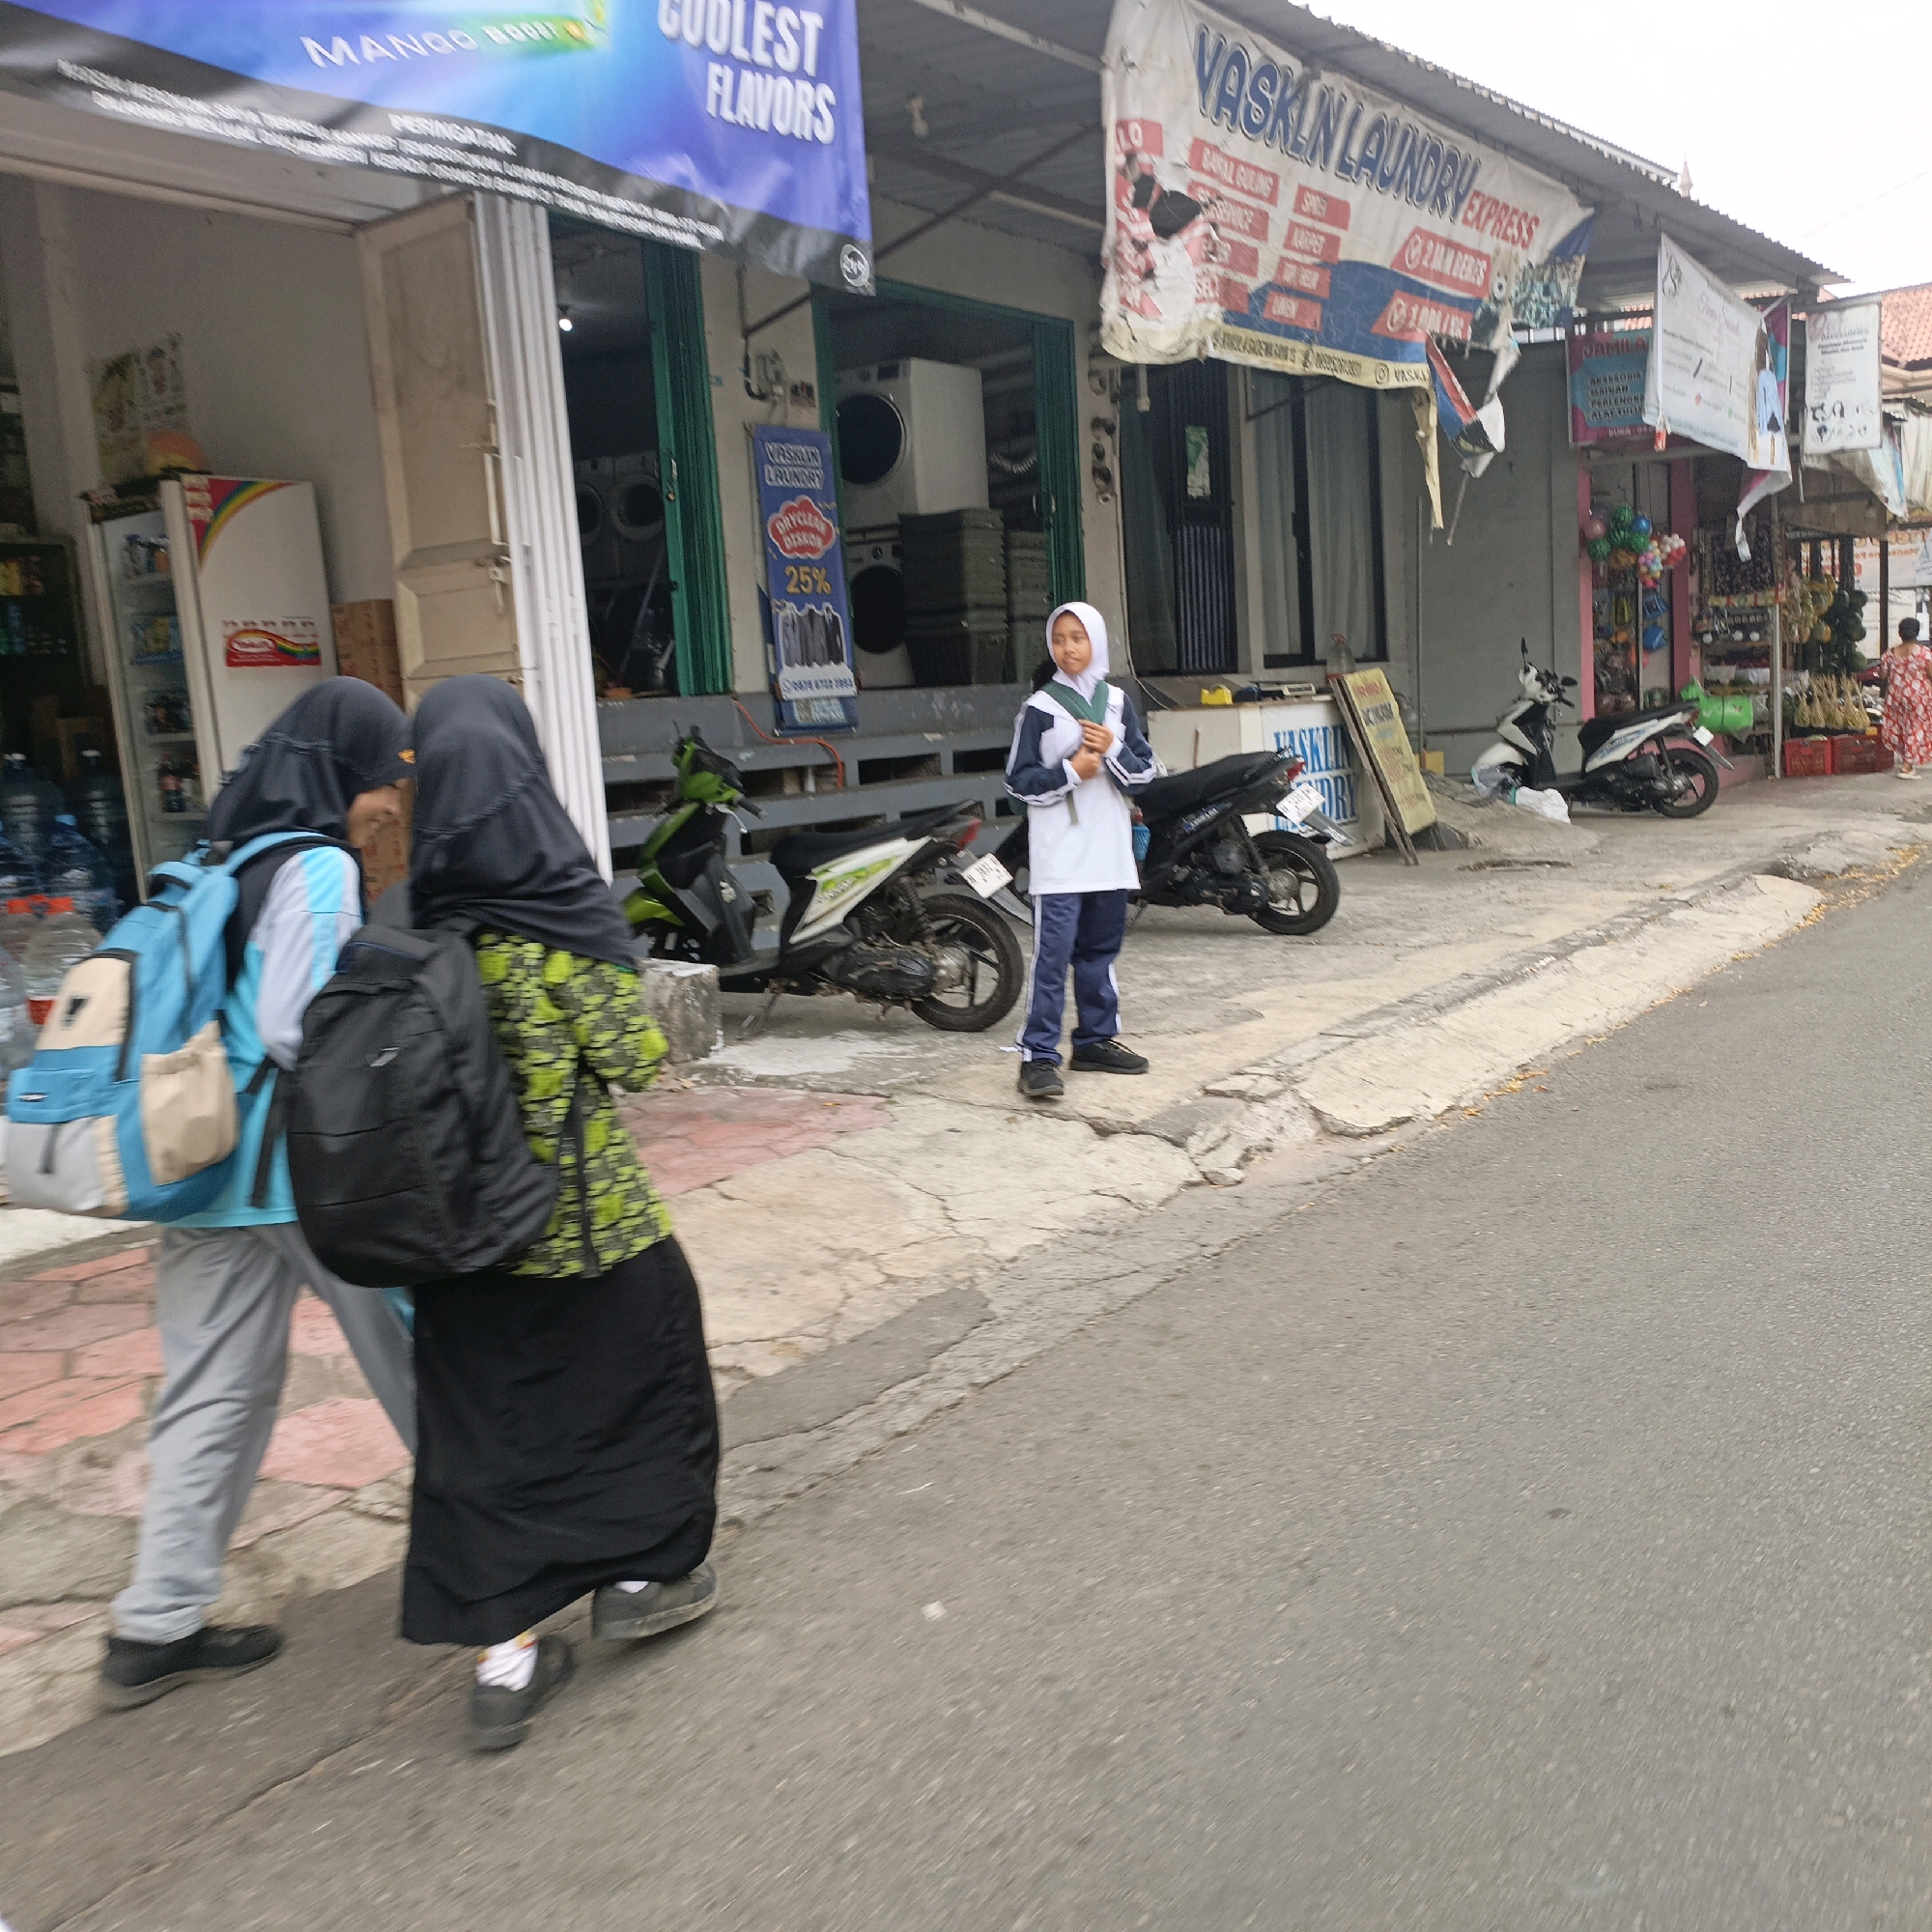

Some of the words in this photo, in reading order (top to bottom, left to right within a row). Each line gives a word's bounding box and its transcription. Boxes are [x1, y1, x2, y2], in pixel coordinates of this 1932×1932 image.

[658, 0, 824, 77] COOLEST
[706, 62, 837, 145] FLAVORS
[1337, 101, 1481, 224] LAUNDRY
[1462, 189, 1540, 251] EXPRESS
[785, 565, 832, 595] 25%
